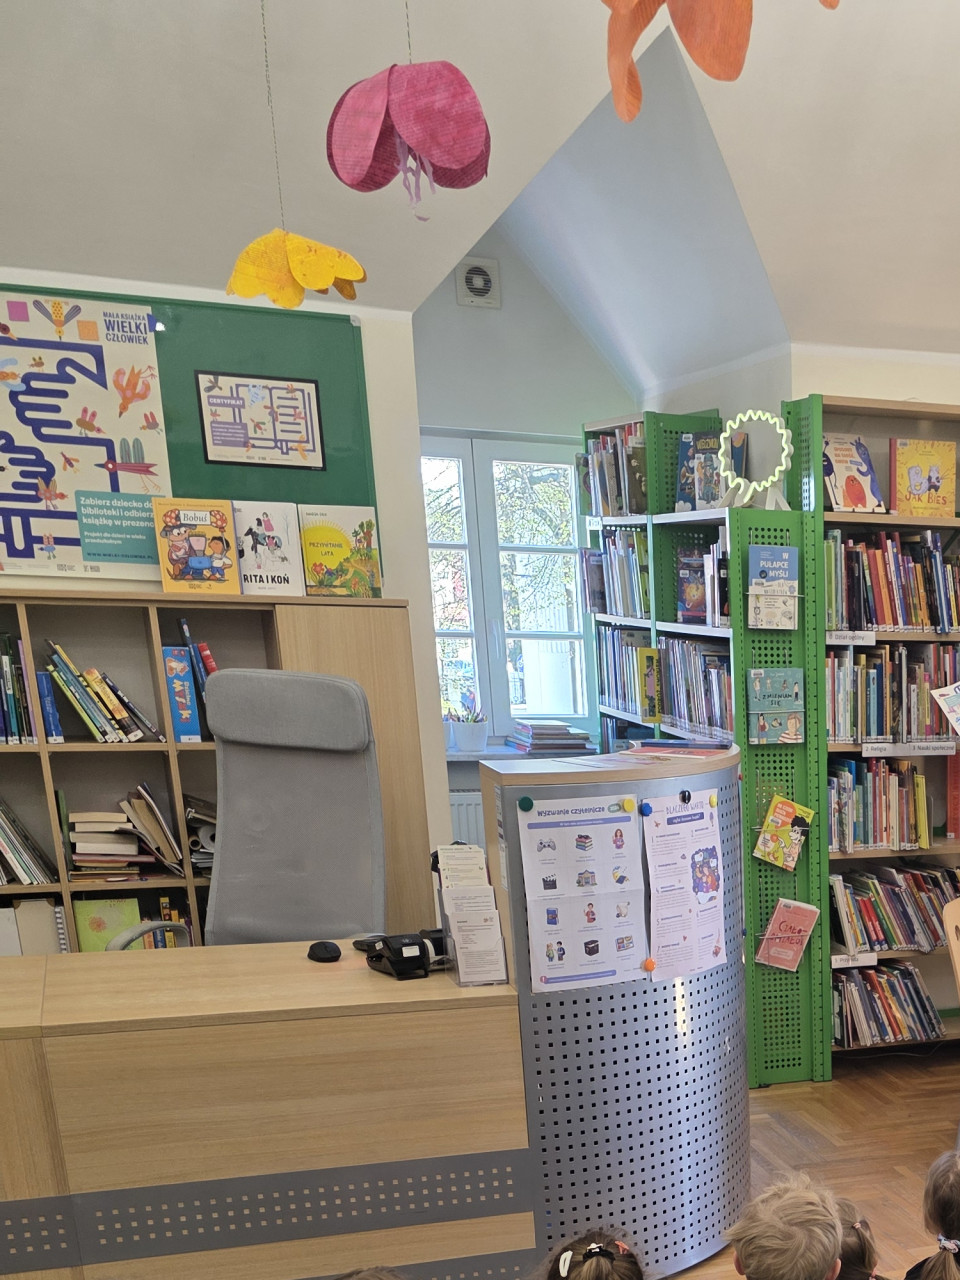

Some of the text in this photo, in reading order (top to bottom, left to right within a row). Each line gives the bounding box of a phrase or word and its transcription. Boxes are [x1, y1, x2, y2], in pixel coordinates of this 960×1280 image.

[103, 311, 146, 321] MAŁA KSIĄŻKA
[104, 319, 148, 335] WIELKI
[106, 333, 149, 345] CZŁOWIEK
[209, 397, 243, 406] CERTYFIKAT
[905, 491, 923, 503] JAK
[80, 497, 110, 506] Zabierz
[112, 498, 143, 508] dziecko
[81, 506, 120, 516] biblioteki
[82, 516, 112, 527] książkę
[183, 513, 208, 522] Bobuś
[782, 552, 789, 560] W
[760, 561, 789, 569] PUŁAPCE
[243, 574, 264, 584] RITA
[270, 573, 290, 584] KOŃ
[769, 570, 789, 578] MYŚLI
[932, 745, 955, 753] społeczne
[537, 805, 605, 817] Wyzwanie czytelnicze
[666, 804, 690, 815] DLACZEGO
